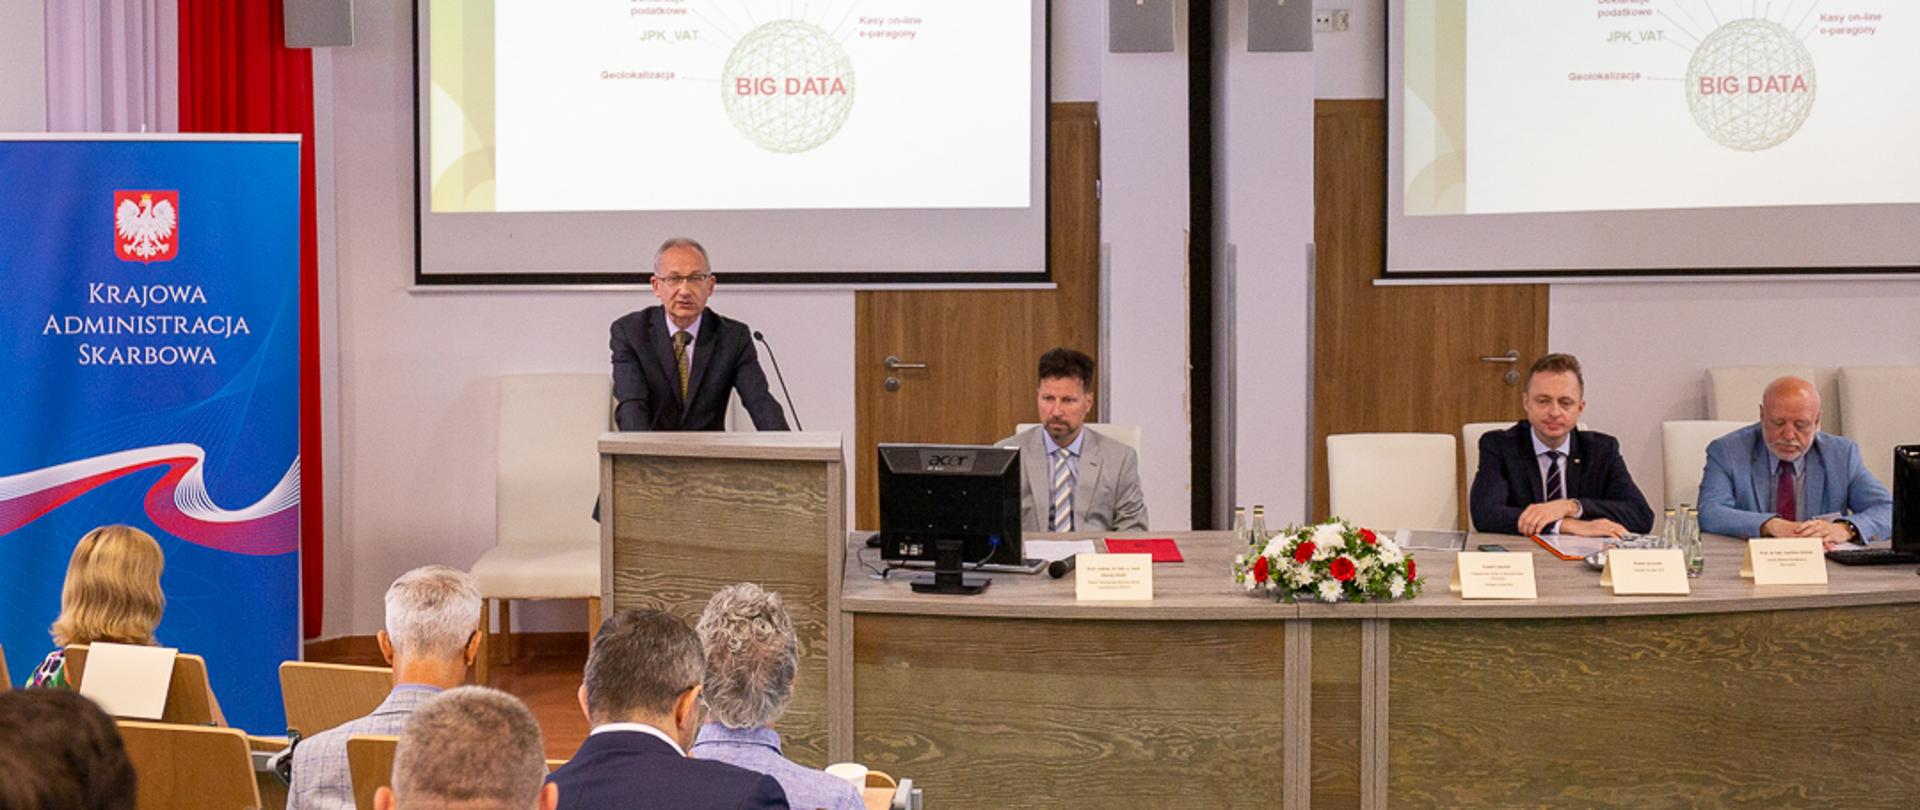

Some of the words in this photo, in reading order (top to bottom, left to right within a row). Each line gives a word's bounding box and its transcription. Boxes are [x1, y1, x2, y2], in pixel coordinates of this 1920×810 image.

[630, 7, 688, 16] podatkowe
[1597, 8, 1653, 19] podatkowe
[859, 16, 884, 26] Kasy
[1819, 13, 1845, 24] Kasy
[1847, 13, 1883, 22] on-line
[640, 29, 700, 44] JPK_VAT
[859, 30, 916, 40] e-paragony
[1819, 26, 1876, 36] e-paragony
[1606, 30, 1664, 45] JPK_VAT
[600, 69, 676, 81] Geolokalizacja
[1568, 71, 1641, 82] Geolokalizacja
[736, 78, 777, 96] BIG
[785, 78, 847, 96] DATA
[1700, 77, 1740, 96] BIG
[1748, 75, 1808, 94] DATA
[88, 282, 207, 308] KRAJOWA
[42, 315, 250, 338] ADMINISTRACJA
[78, 343, 217, 365] SKARBOWA
[928, 455, 968, 466] acer
